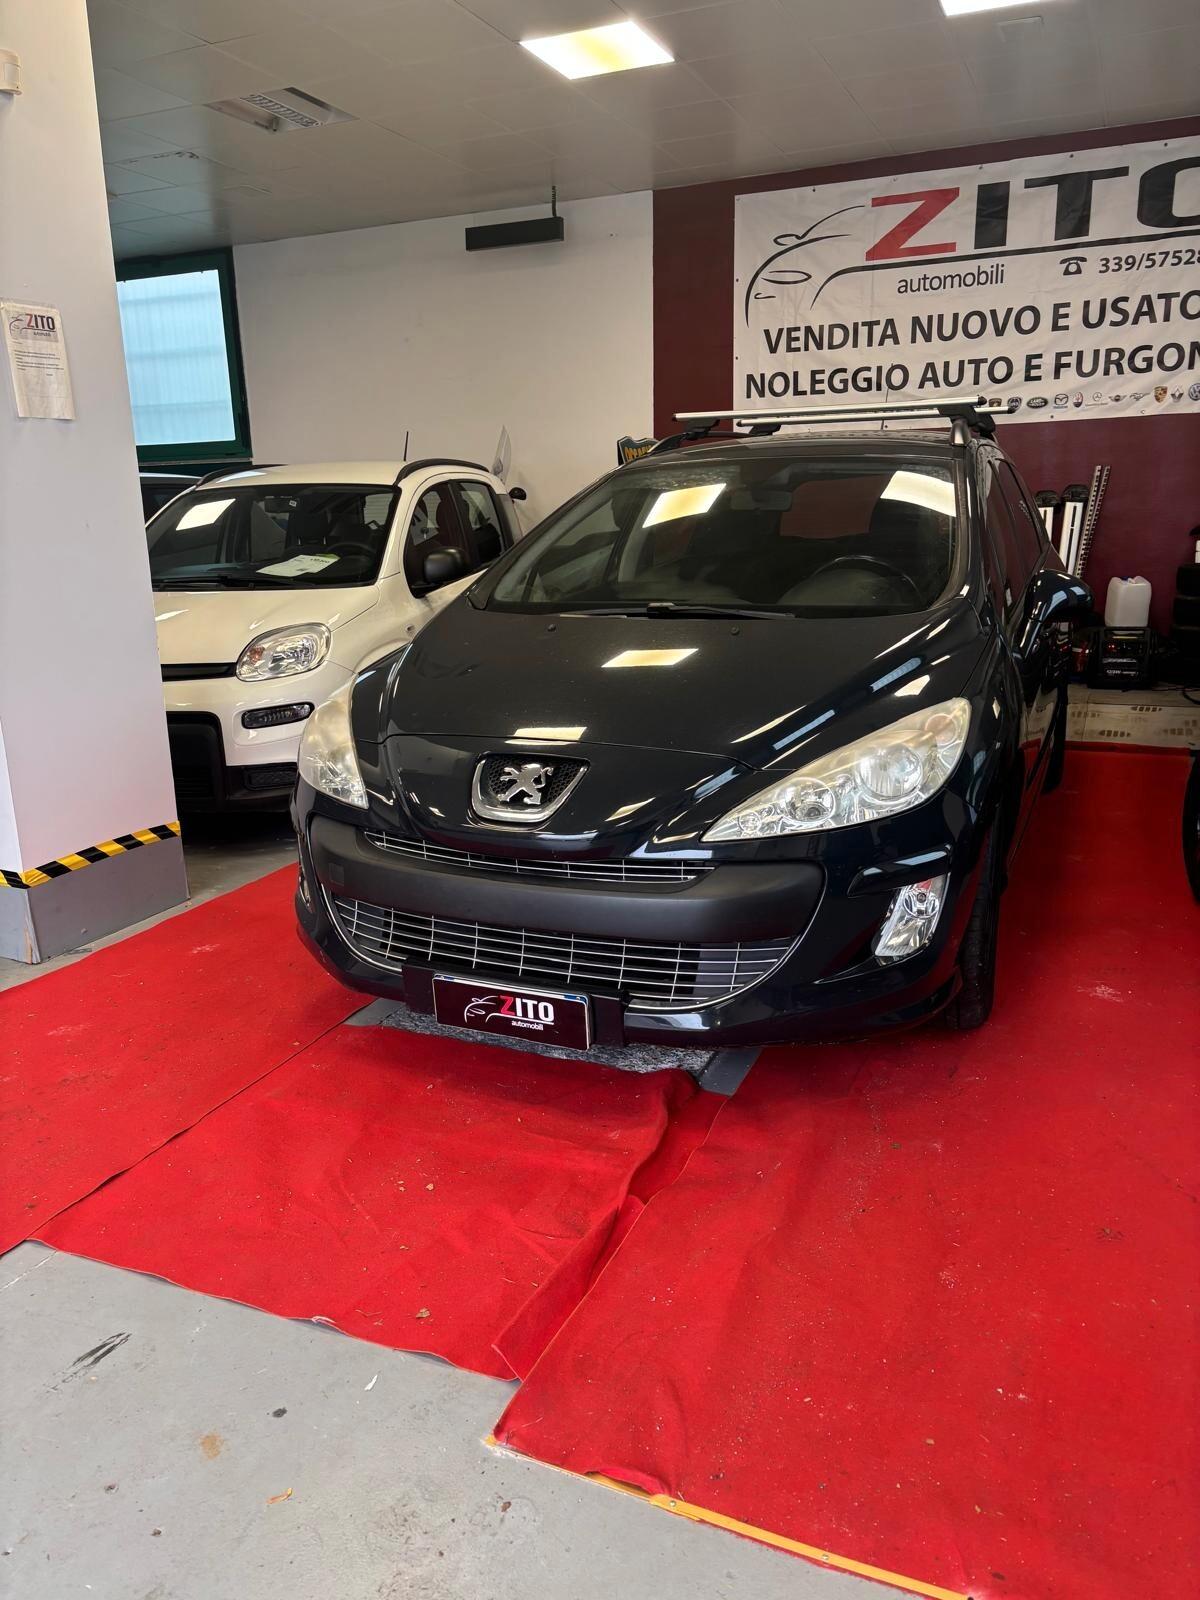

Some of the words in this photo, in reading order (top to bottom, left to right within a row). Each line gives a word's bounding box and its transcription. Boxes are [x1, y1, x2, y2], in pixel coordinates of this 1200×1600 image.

[1098, 248, 1200, 274] 339/5752
[897, 263, 1005, 294] automobili
[25, 313, 56, 330] ZITO
[763, 318, 901, 354] VENDITA
[910, 306, 1041, 344] NUOVO
[1051, 301, 1071, 331] E
[746, 364, 910, 399] NOLEGGIO
[918, 355, 1014, 389] AUTO
[1024, 353, 1043, 382] E
[500, 995, 554, 1021] ZITO
[511, 1020, 543, 1031] automobili
